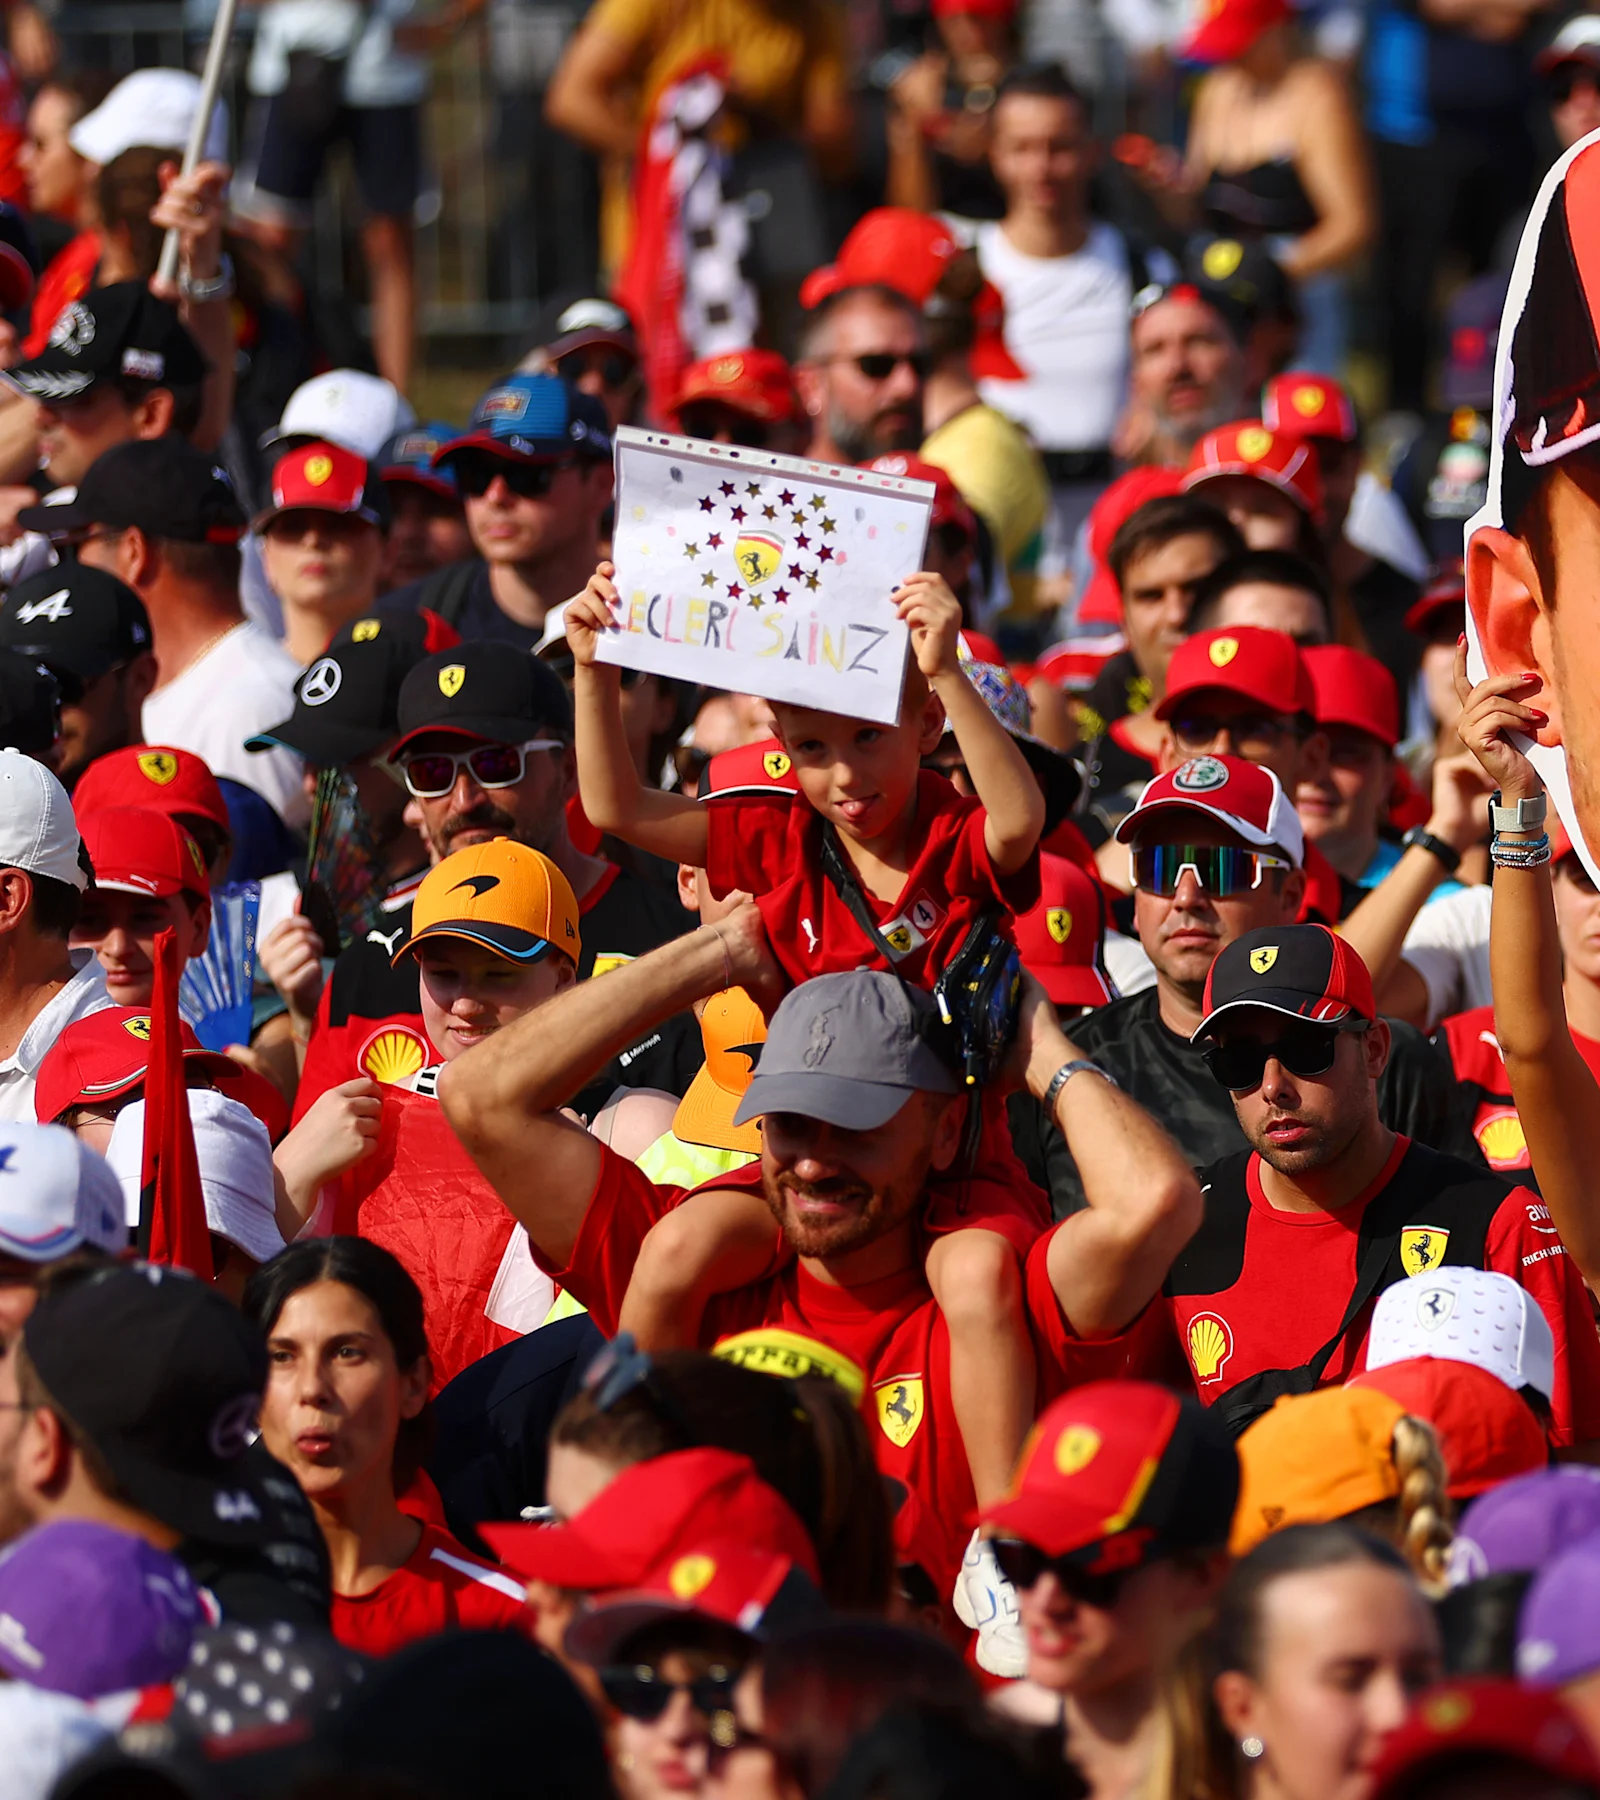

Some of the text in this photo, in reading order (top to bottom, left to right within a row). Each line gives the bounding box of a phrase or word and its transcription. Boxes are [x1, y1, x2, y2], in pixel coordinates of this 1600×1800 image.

[757, 610, 889, 675] SAINZ
[916, 902, 934, 922] 4
[629, 1033, 662, 1059] Microsoft
